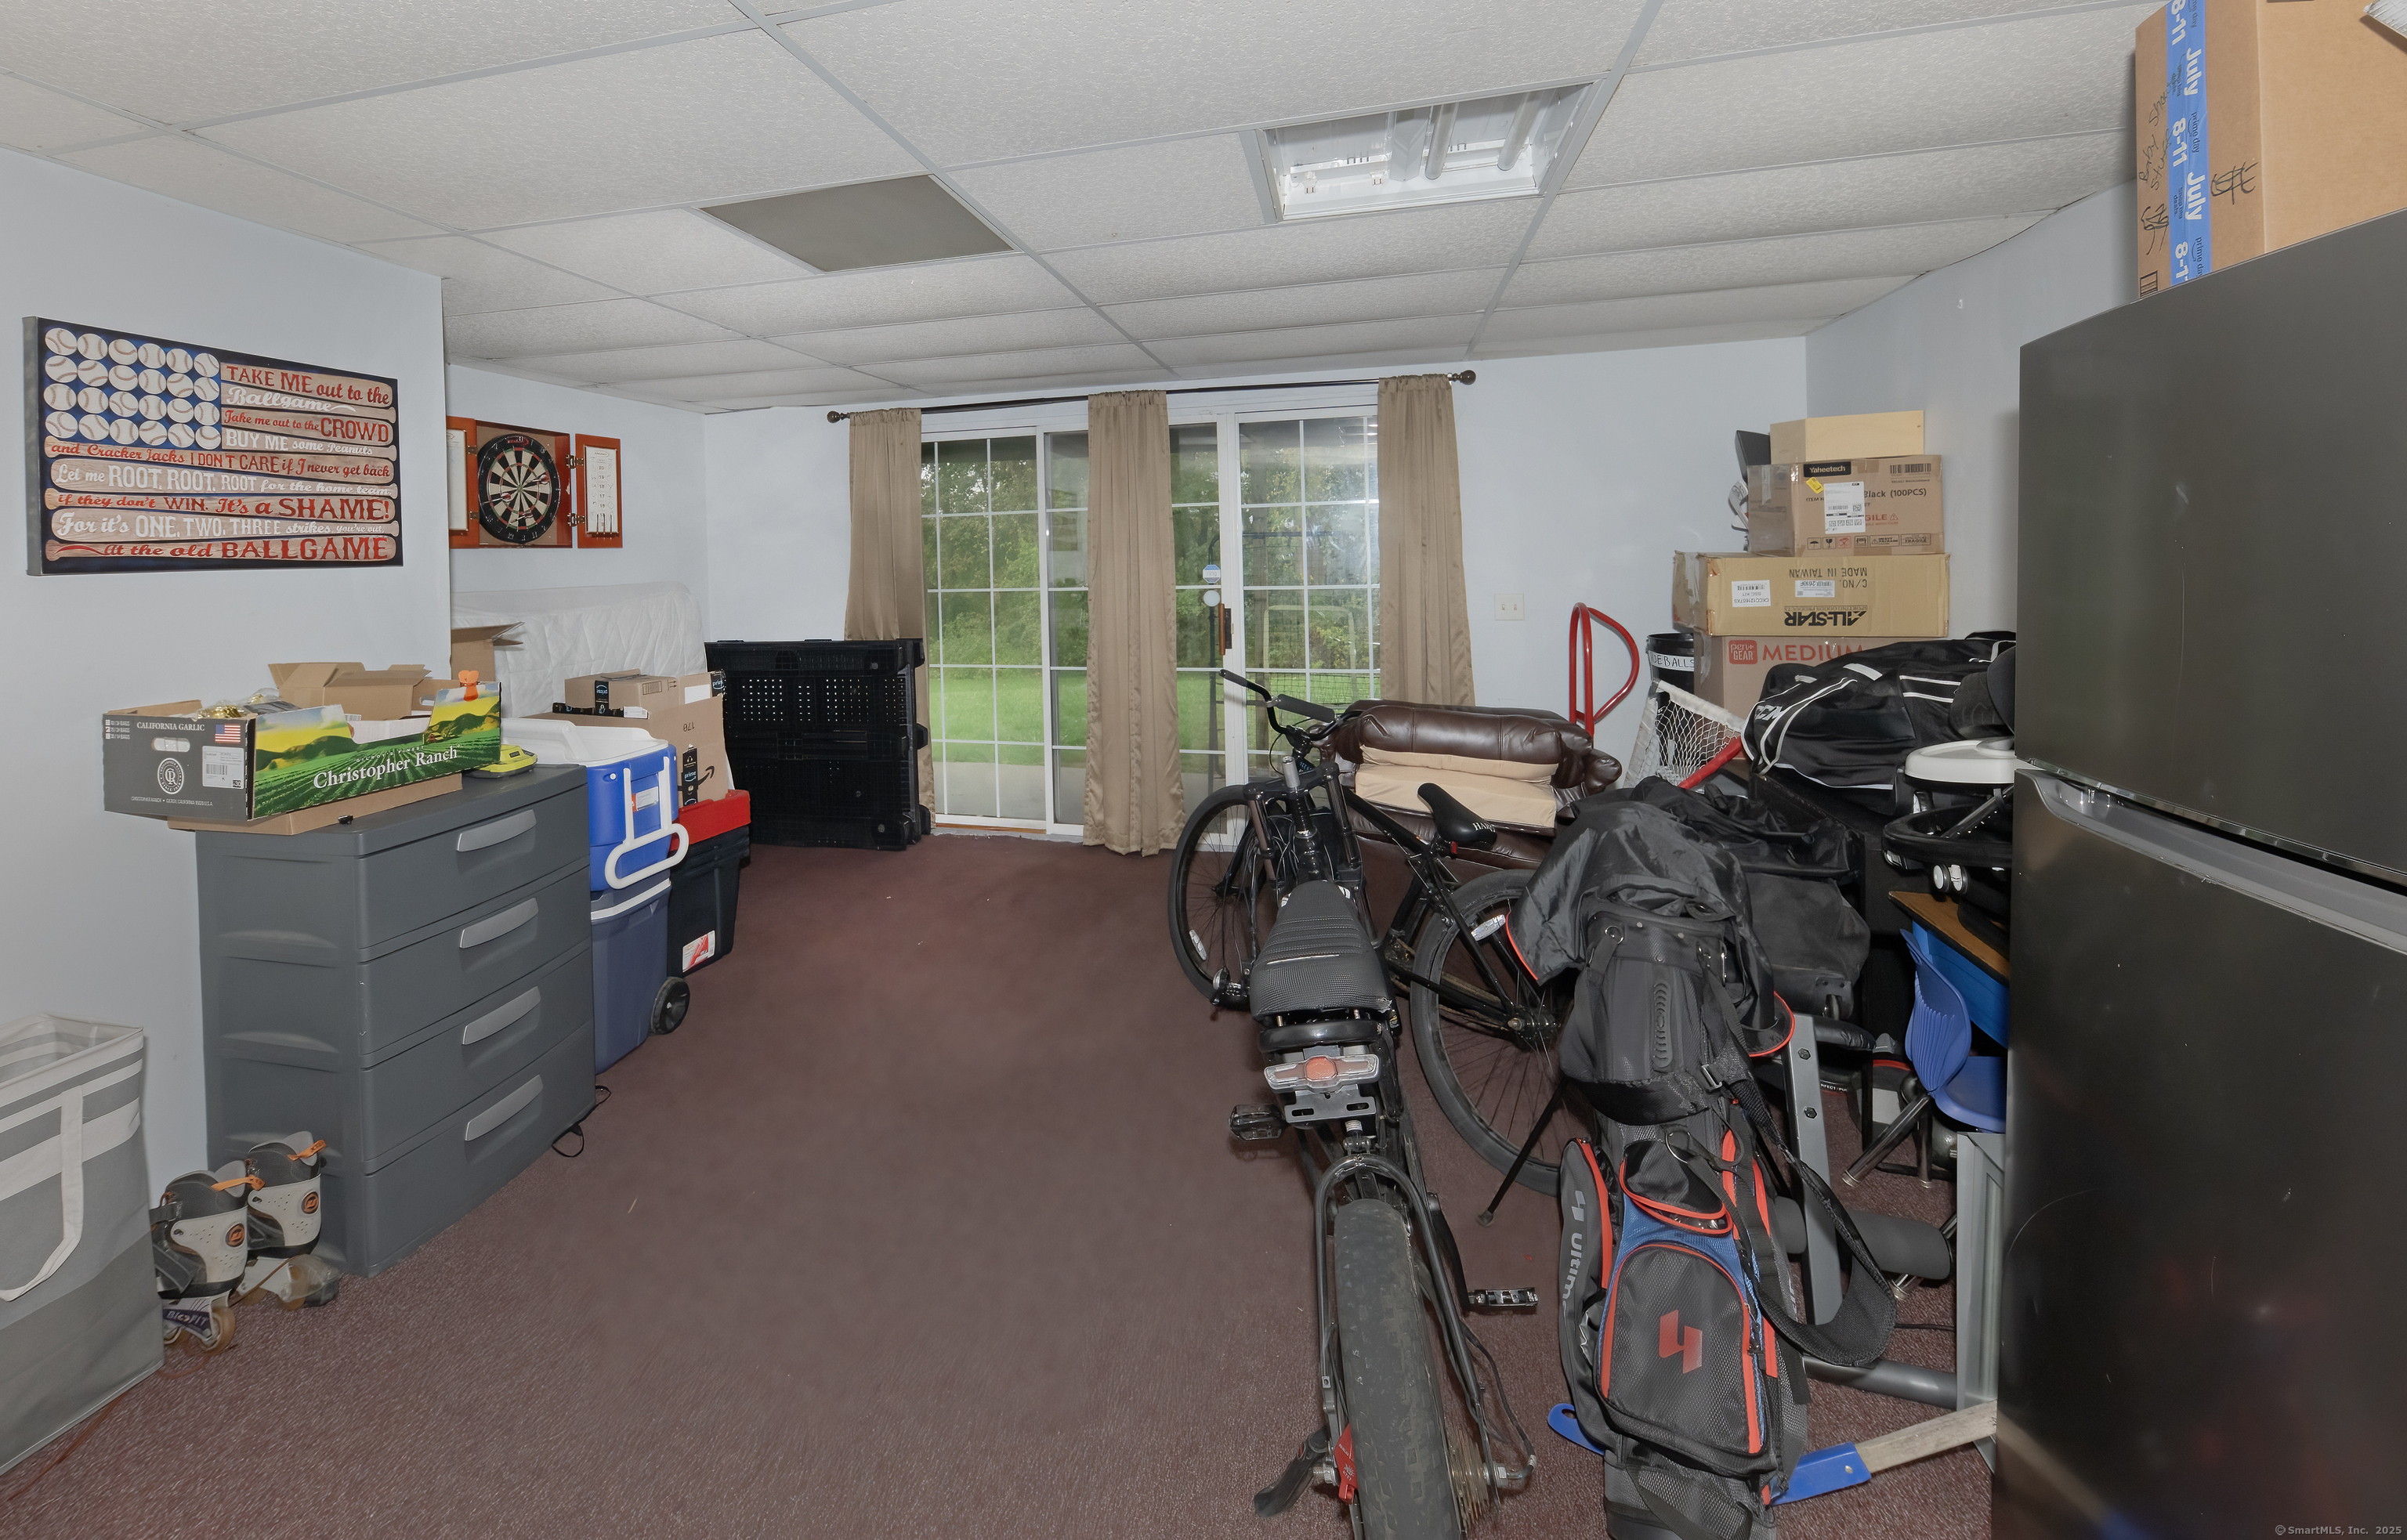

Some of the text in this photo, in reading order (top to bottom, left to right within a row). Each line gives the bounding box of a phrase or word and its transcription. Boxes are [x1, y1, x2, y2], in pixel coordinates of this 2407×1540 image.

[2184, 47, 2202, 96] July
[2172, 117, 2188, 168] 8-11
[2192, 138, 2200, 153] day
[2184, 172, 2206, 220] July
[2175, 241, 2189, 281] 8-1
[226, 365, 390, 405] TAKE ME out to the
[226, 386, 357, 412] Ballgame
[224, 410, 252, 425] Take
[272, 418, 290, 428] out
[292, 420, 302, 428] to
[304, 421, 319, 431] the
[320, 417, 389, 443] CROWD
[226, 428, 373, 455] BUY ME some Peanuts
[51, 443, 81, 454] and
[87, 444, 143, 460] Cracker
[146, 449, 186, 464] Jacks
[190, 452, 194, 465] I
[239, 454, 280, 473] CARE
[281, 458, 295, 475] if
[295, 458, 307, 475] I
[307, 465, 340, 474] never
[343, 465, 360, 478] get
[363, 464, 390, 477] back
[1809, 465, 1846, 474] Yaheetech
[55, 464, 81, 483] Let
[85, 472, 106, 483] me
[221, 474, 258, 491] ROOT
[259, 480, 285, 493] for
[289, 480, 312, 492] the
[316, 483, 353, 493] home
[1890, 487, 1927, 498] (100PCS)
[58, 493, 74, 505] if
[77, 495, 112, 507] they
[116, 496, 157, 508] don't
[215, 498, 249, 514] It's
[255, 501, 273, 515] a
[278, 497, 389, 520] SHAME!
[56, 512, 97, 536] For
[100, 514, 130, 533] it's
[230, 519, 281, 535] THREE
[336, 523, 367, 533] you're
[104, 537, 388, 560] At the old BALLGAME
[1789, 567, 1867, 578] MADE IN TAIWAN
[1839, 580, 1868, 589] C/NO.
[1783, 611, 1867, 627] ALL-STAR
[1733, 650, 1754, 660] GEAR
[136, 721, 205, 732] CALIFORNIA GARLIC
[313, 746, 458, 790] Christopher Ranch
[684, 771, 697, 779] prime
[1562, 1232, 1583, 1302] Ultim
